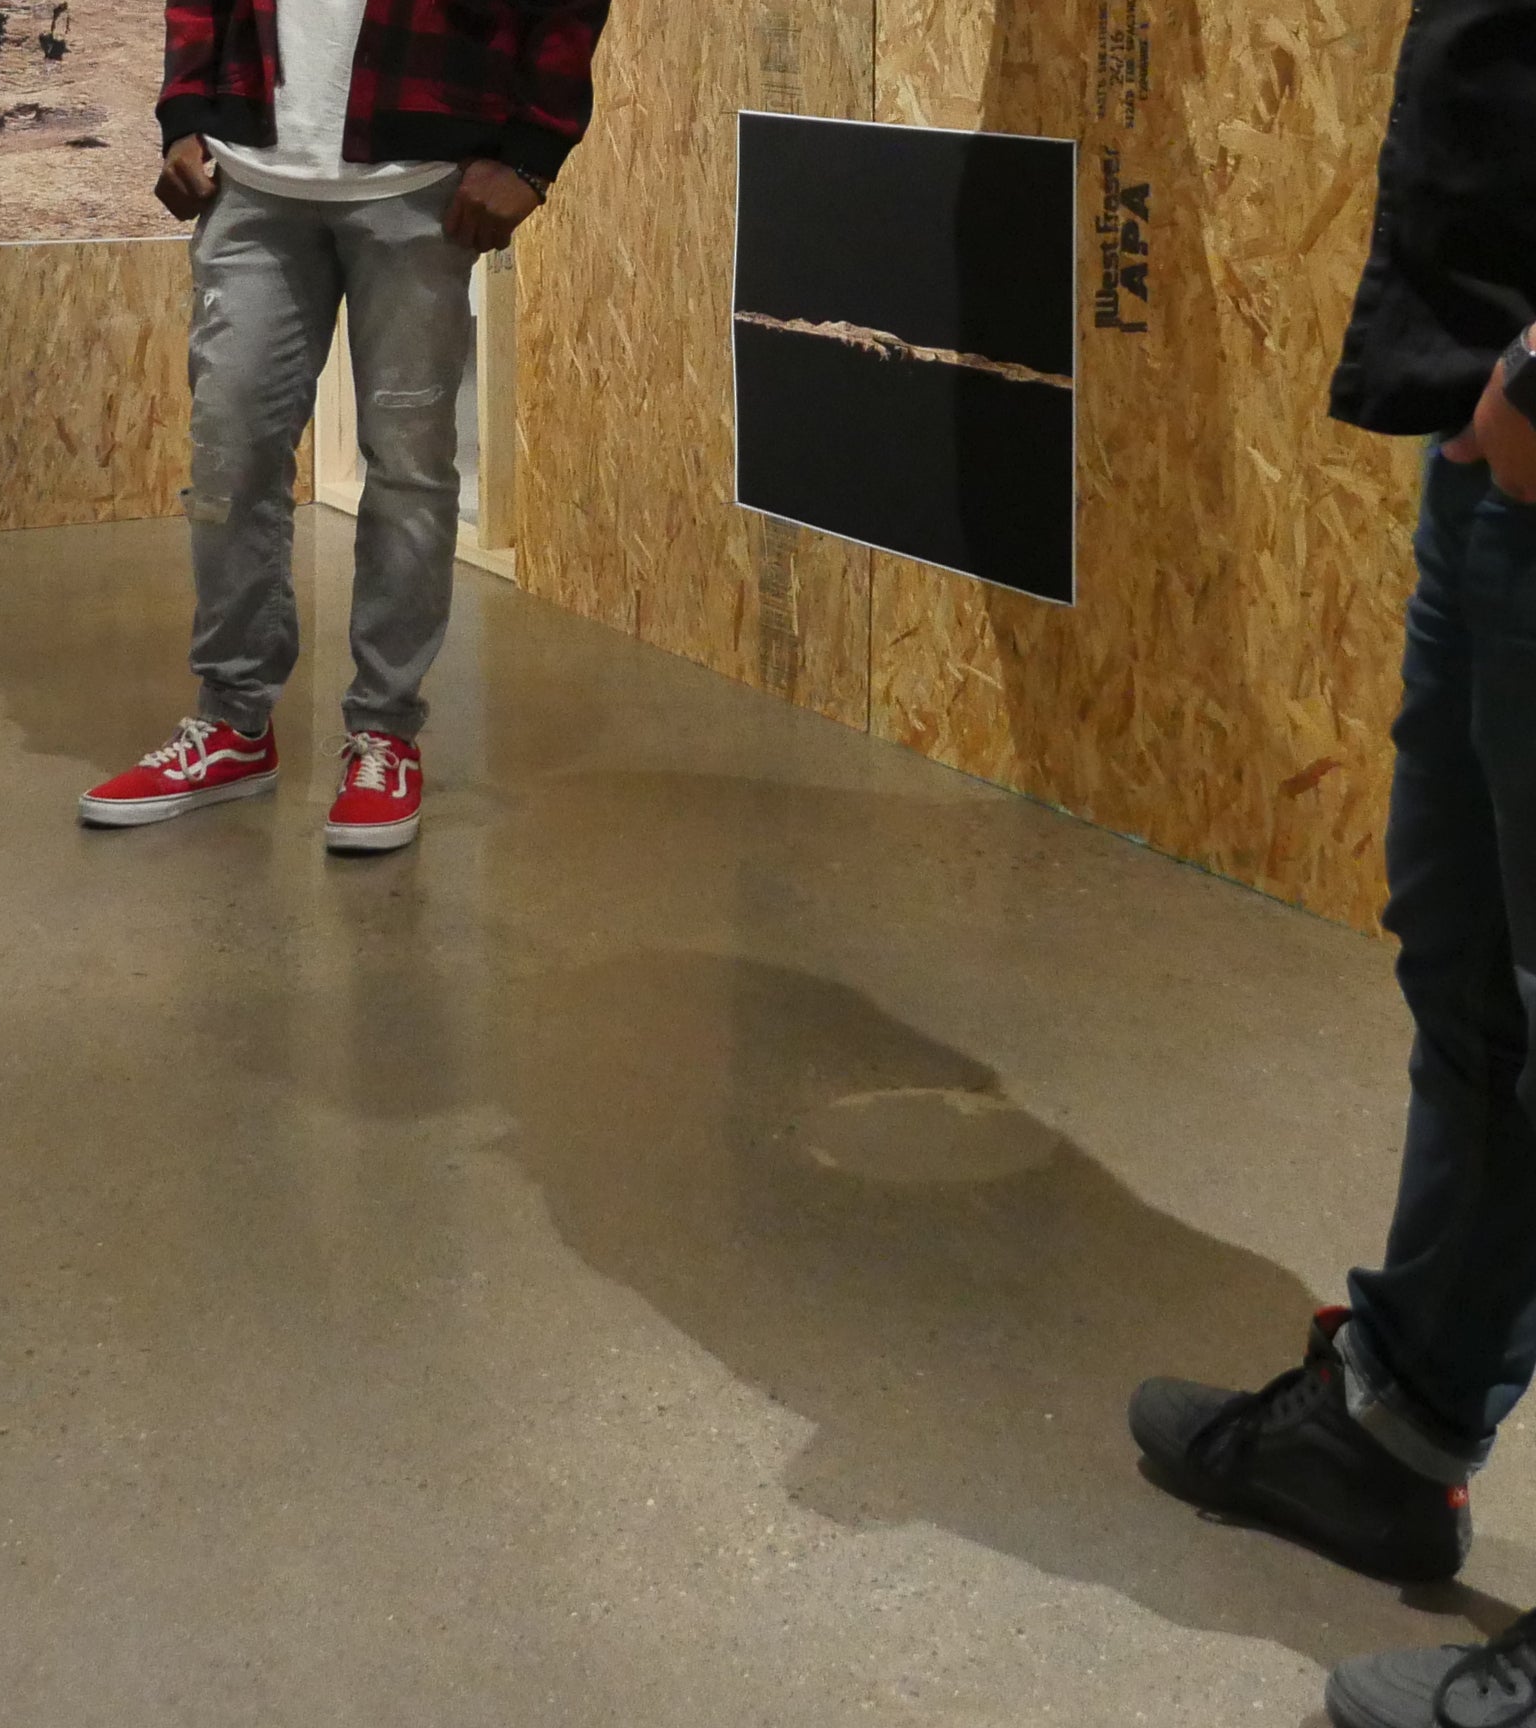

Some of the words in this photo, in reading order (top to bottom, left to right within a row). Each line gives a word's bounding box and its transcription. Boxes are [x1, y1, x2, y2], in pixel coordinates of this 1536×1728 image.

[1095, 145, 1119, 234] Fraser
[1095, 242, 1118, 317] West
[1120, 182, 1150, 302] APA
